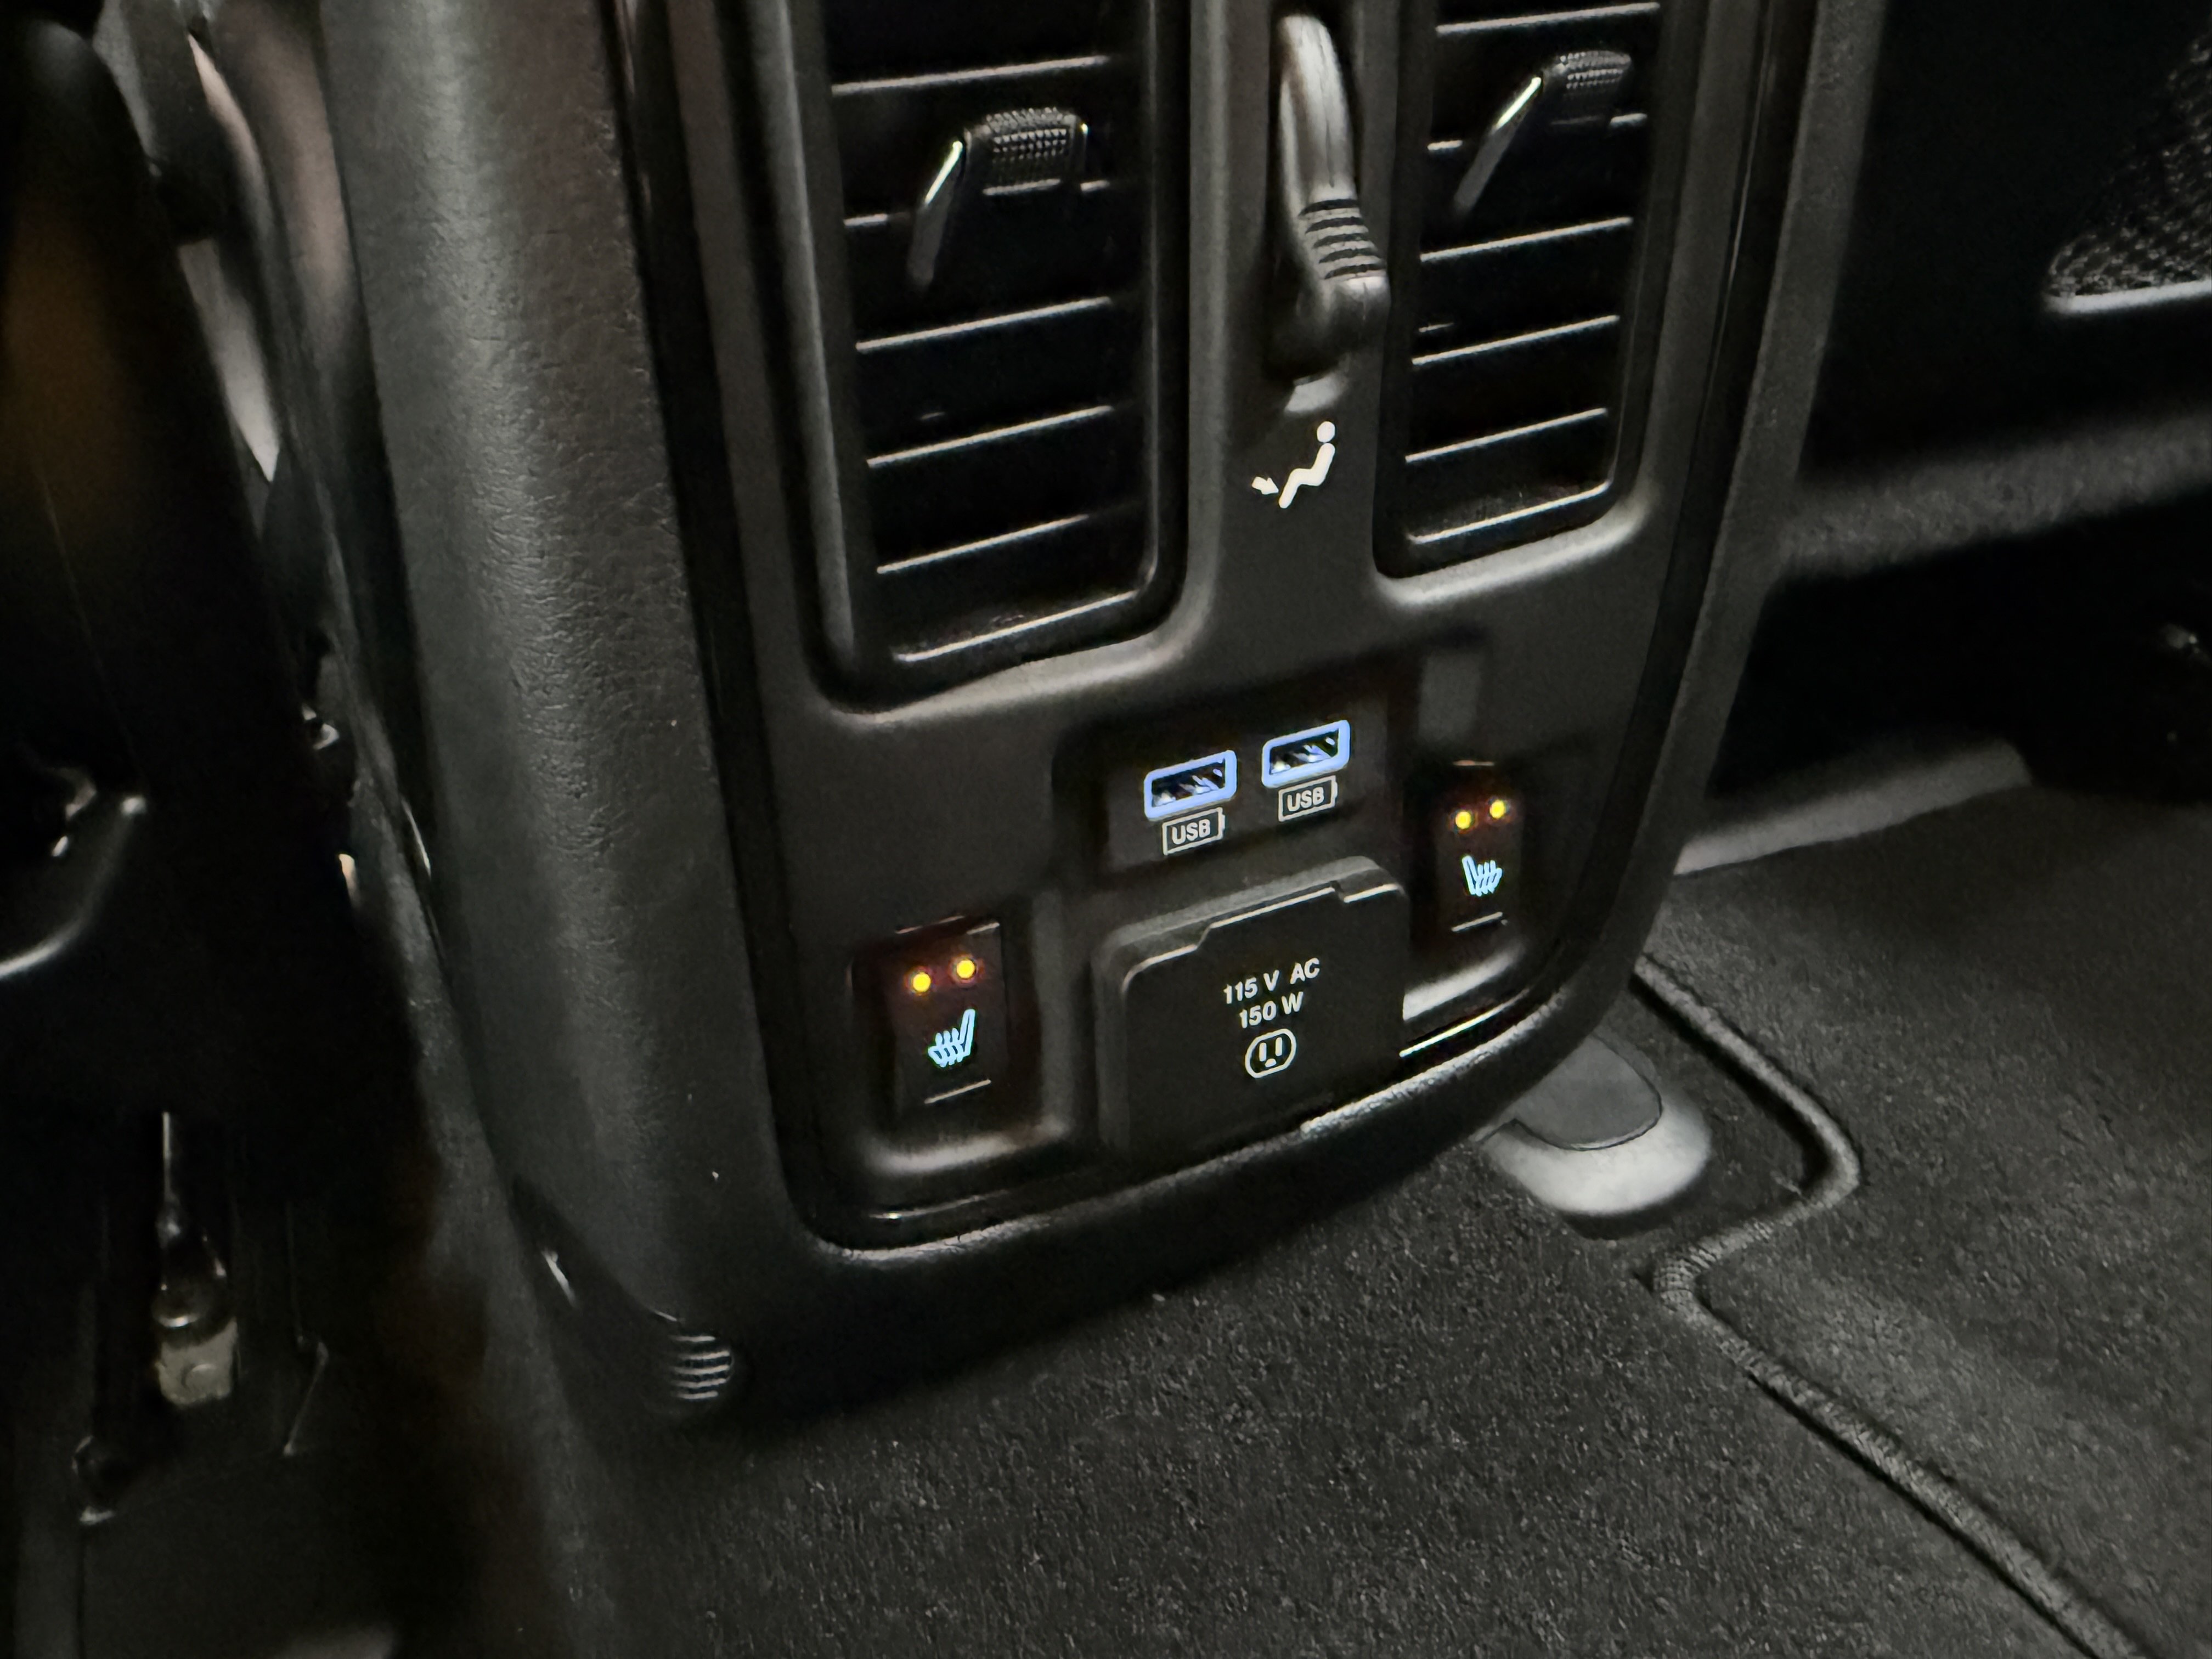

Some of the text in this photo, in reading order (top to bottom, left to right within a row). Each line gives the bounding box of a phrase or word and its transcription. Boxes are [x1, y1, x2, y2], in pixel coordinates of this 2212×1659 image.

[1286, 786, 1325, 812] USB
[1171, 819, 1211, 845] USB
[1223, 957, 1321, 1004] 115 V AC
[1239, 991, 1304, 1029] 150 W
